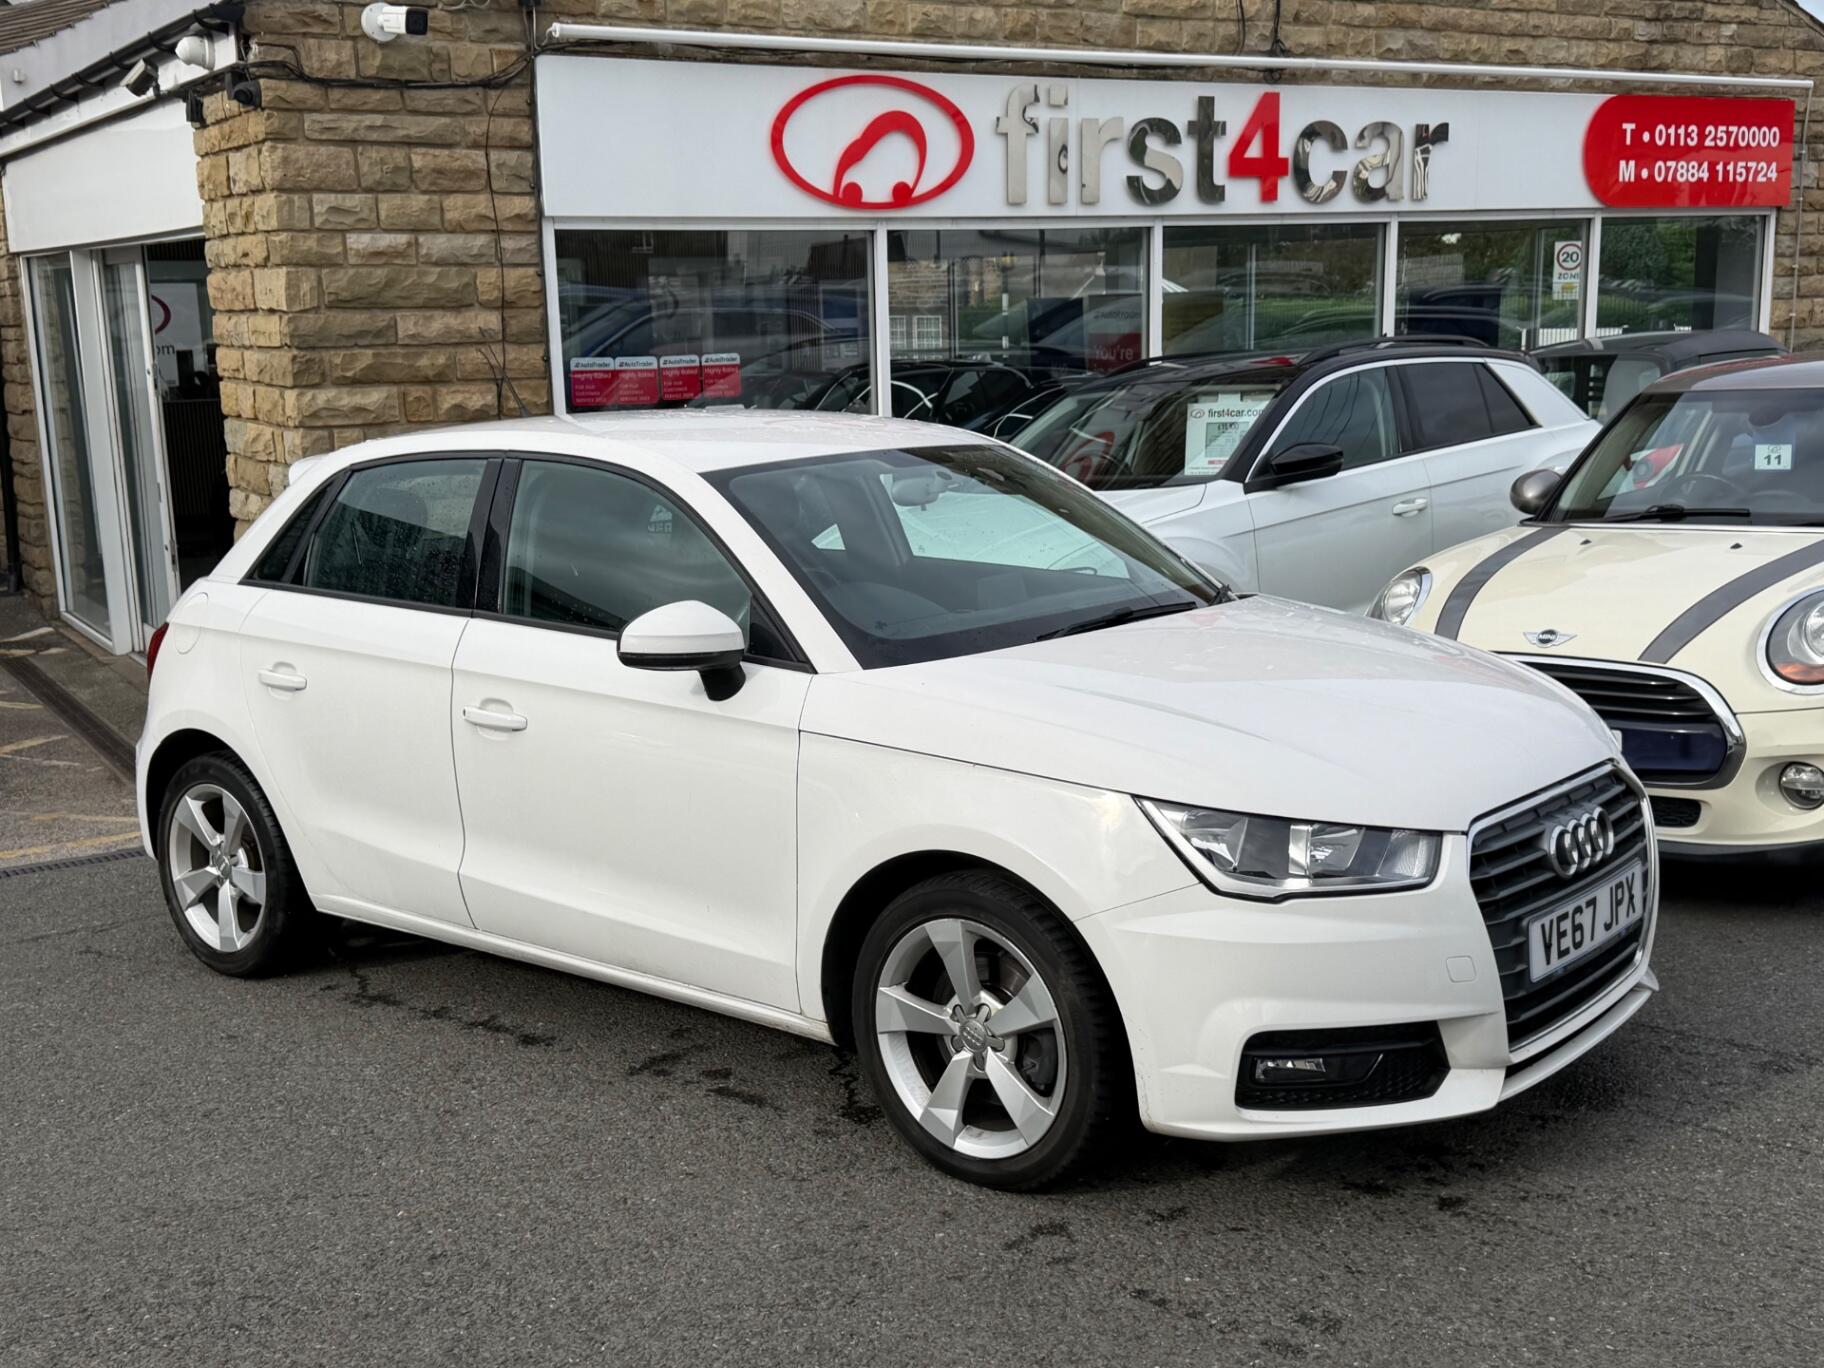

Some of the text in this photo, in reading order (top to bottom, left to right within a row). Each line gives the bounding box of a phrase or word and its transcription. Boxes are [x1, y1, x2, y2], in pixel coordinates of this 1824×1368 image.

[996, 83, 1450, 206] first4car
[1622, 123, 1780, 148] T 0113 2570000
[1619, 160, 1777, 183] M 07884 115724
[1561, 251, 1579, 263] 20
[1094, 344, 1135, 361] You're
[1764, 454, 1782, 466] 11
[1540, 871, 1637, 966] VE67 JPX
